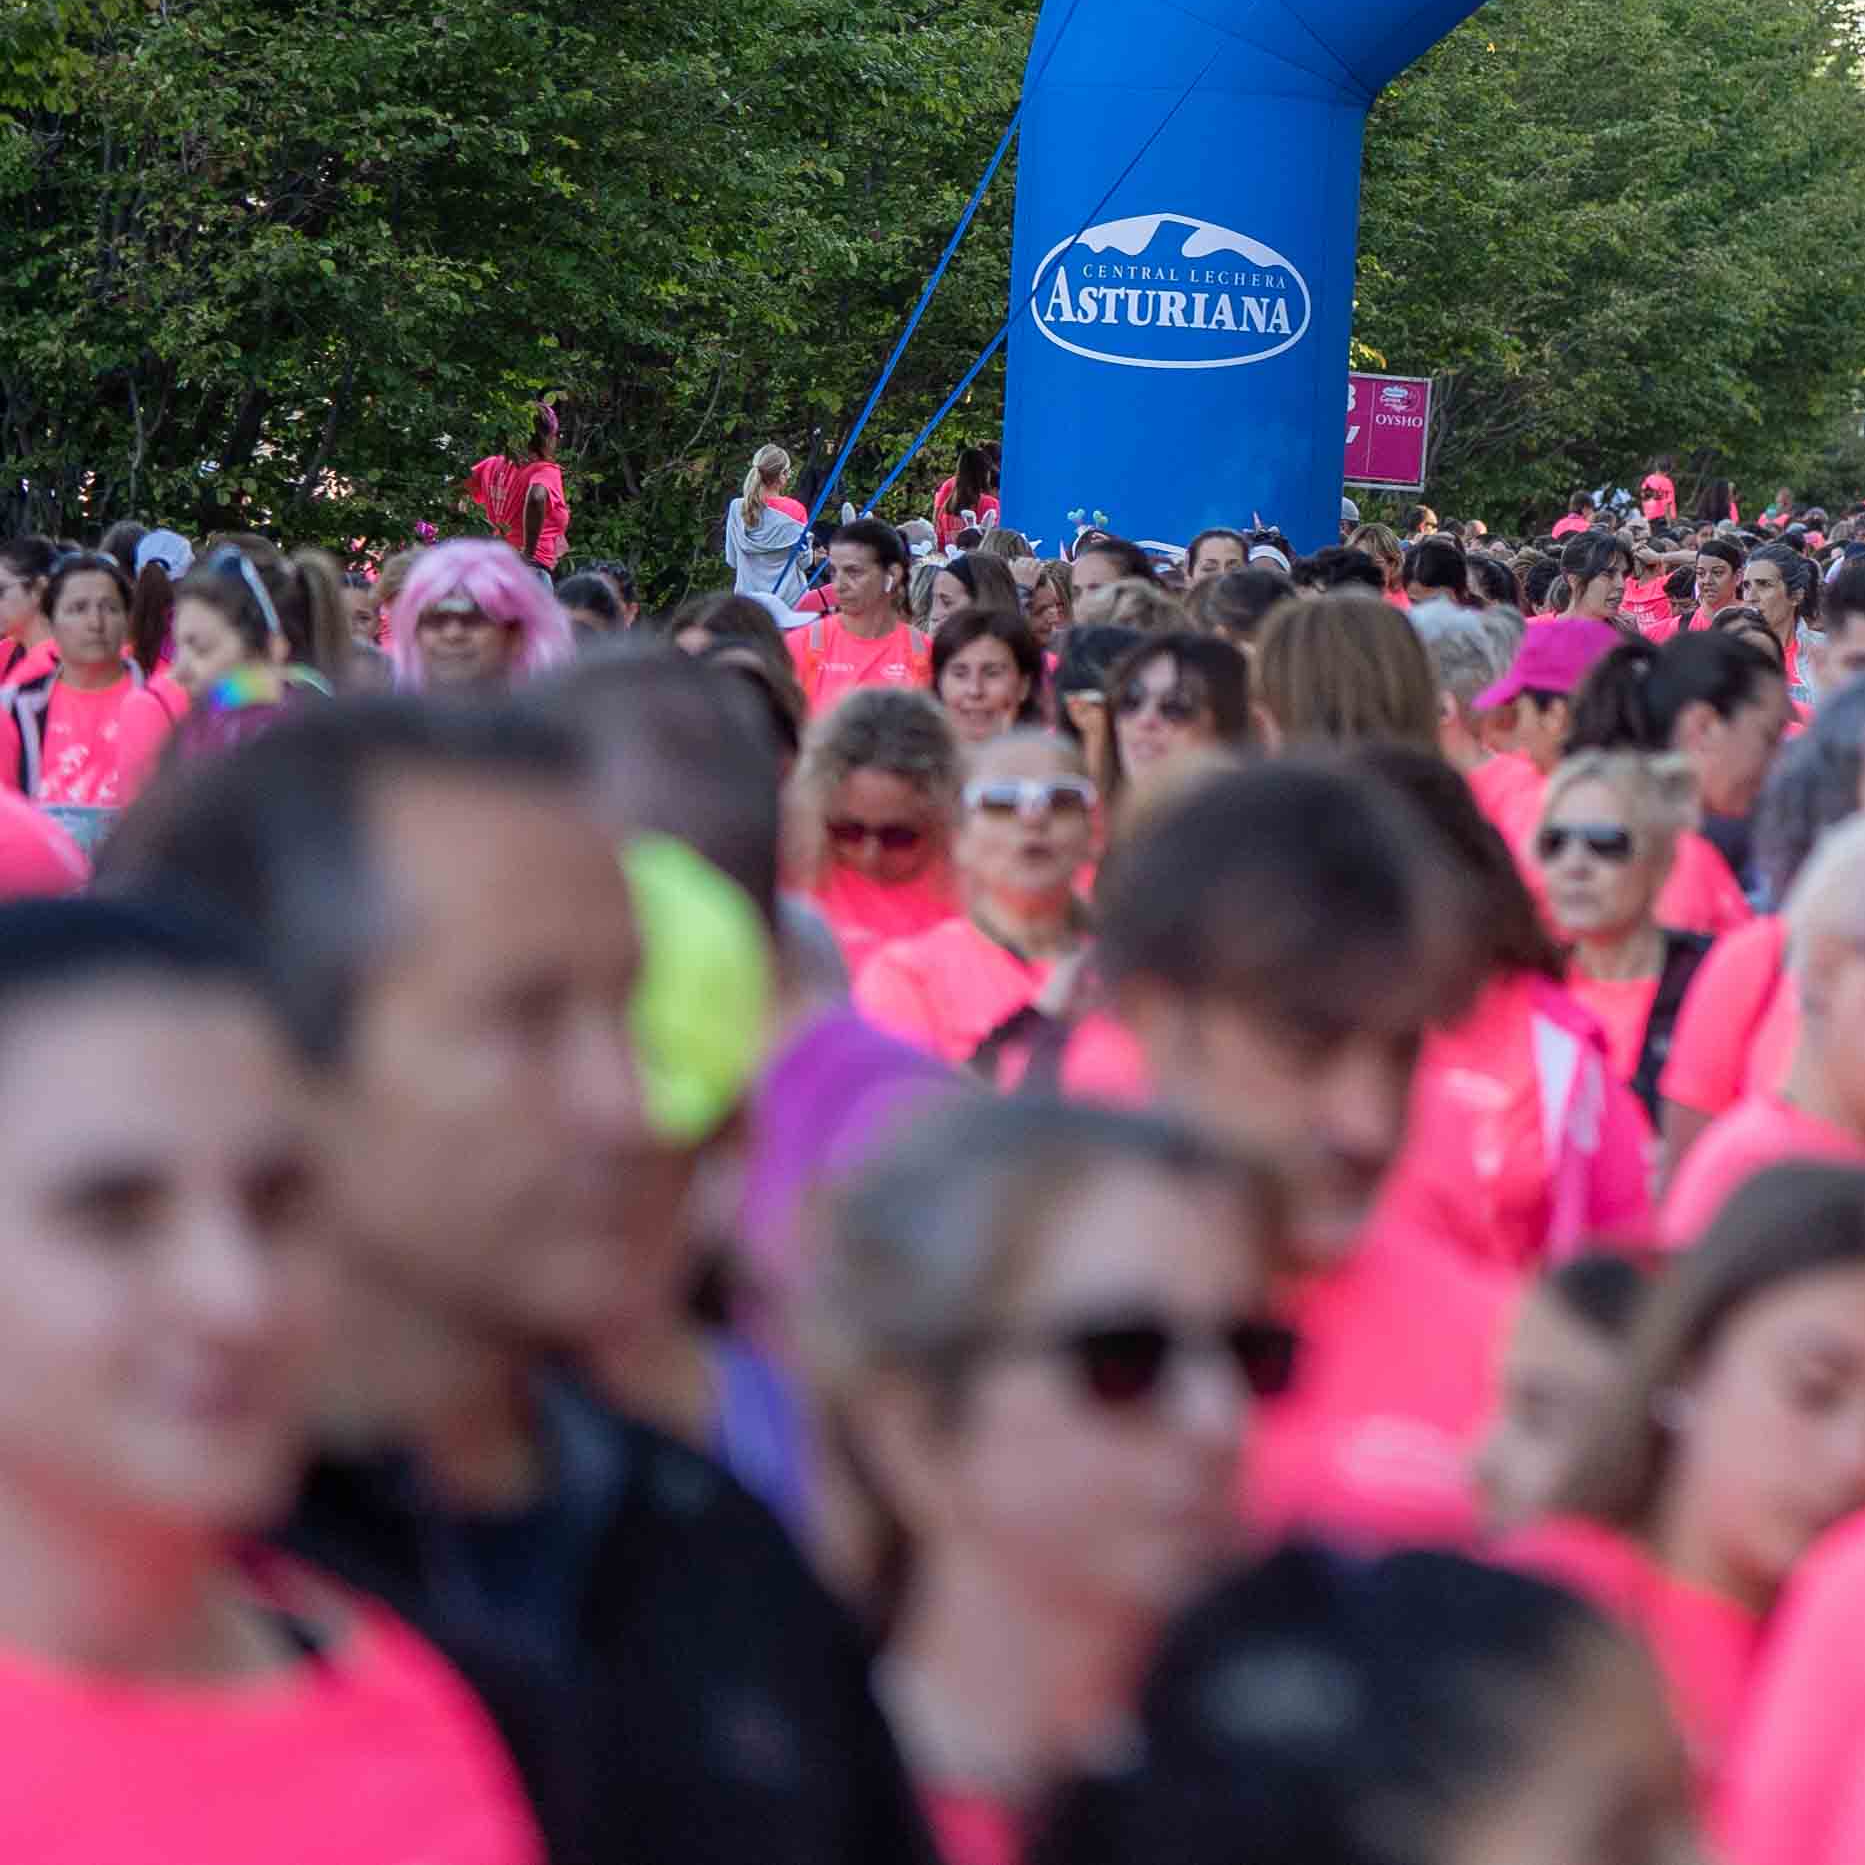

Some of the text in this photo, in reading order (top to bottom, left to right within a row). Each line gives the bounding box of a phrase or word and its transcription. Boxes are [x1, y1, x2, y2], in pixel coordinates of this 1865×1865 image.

[1083, 264, 1287, 289] CENTRAL LECHERA
[1043, 266, 1292, 335] ASTURIANA
[1376, 414, 1423, 428] OYSHO
